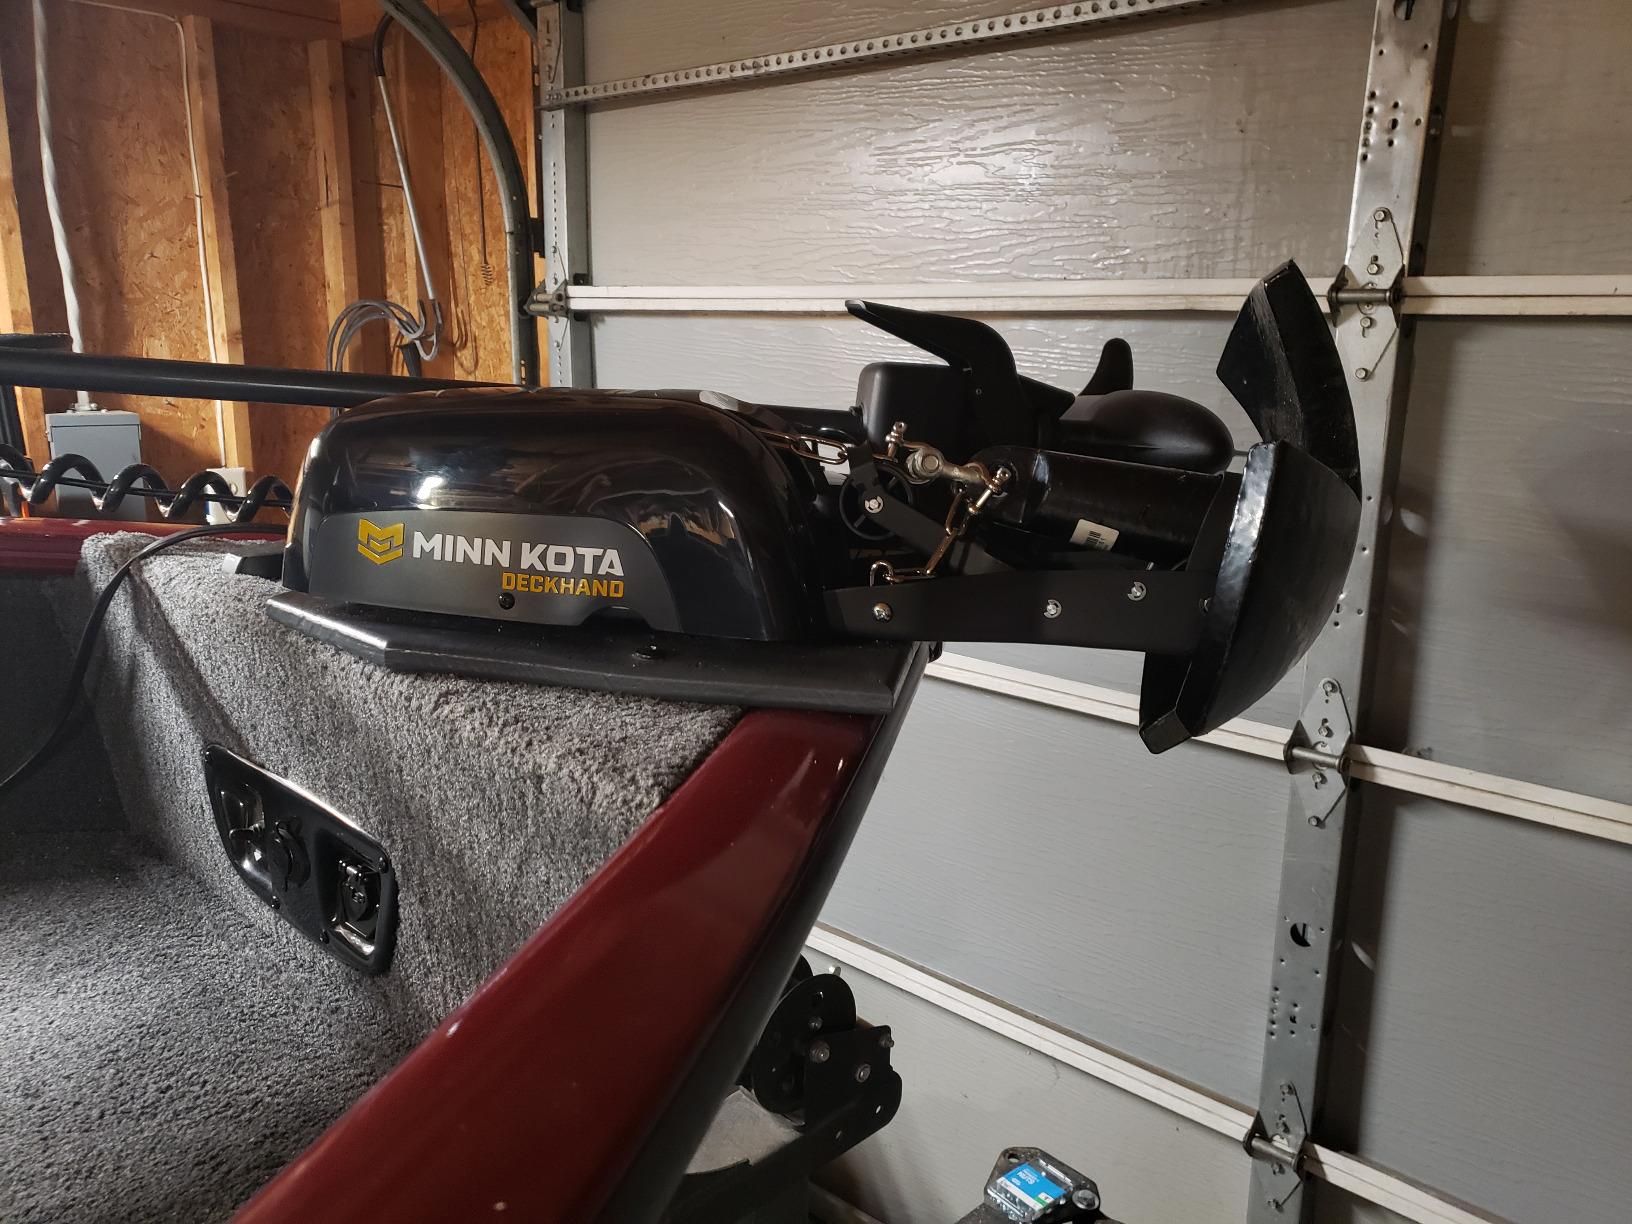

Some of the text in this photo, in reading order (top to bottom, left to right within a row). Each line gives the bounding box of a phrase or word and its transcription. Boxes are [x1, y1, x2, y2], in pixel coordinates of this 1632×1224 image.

[412, 531, 624, 577] MINN KOTA
[502, 572, 625, 598] DECKHAND
